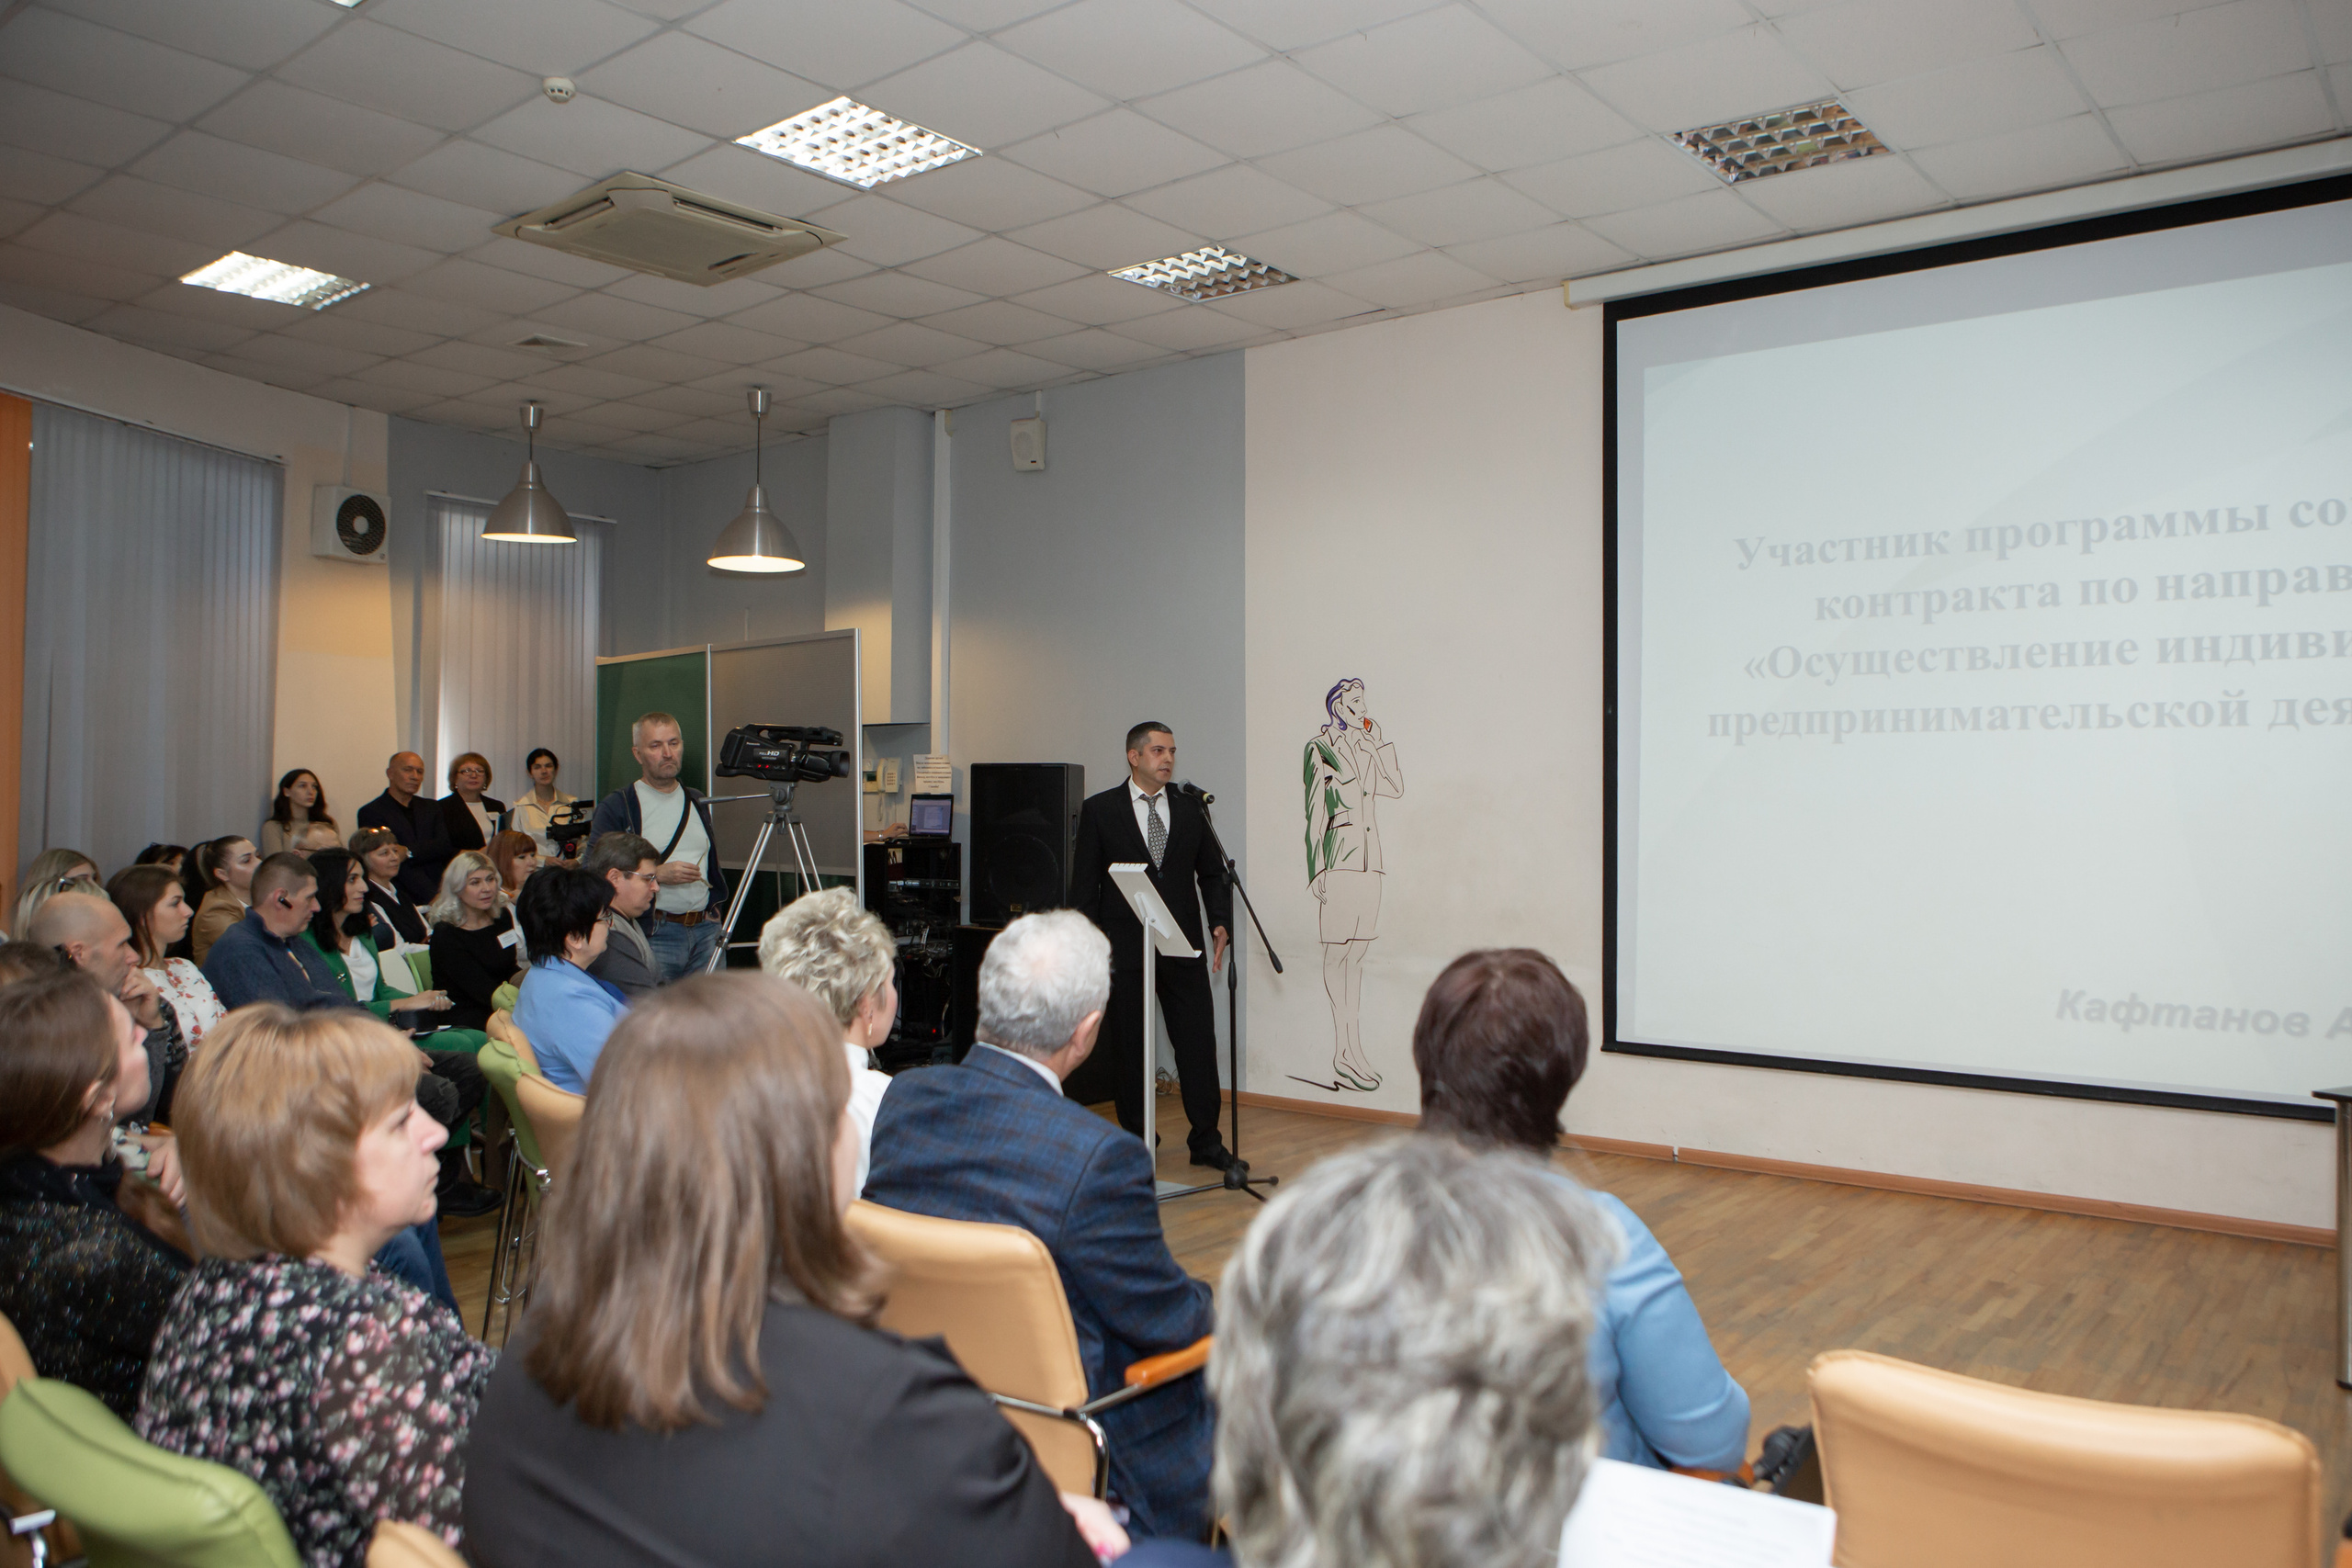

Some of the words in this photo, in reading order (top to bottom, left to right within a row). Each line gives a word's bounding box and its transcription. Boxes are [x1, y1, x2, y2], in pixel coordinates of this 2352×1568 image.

[1733, 529, 1951, 570] Участник
[1964, 504, 2270, 561] программы
[2289, 498, 2352, 529] со
[1815, 581, 2063, 625] контракта
[2078, 577, 2139, 606] по
[2154, 564, 2352, 607] направ
[1744, 638, 2140, 687] «Осуществление
[1707, 689, 2251, 746] предпринимательской
[2055, 987, 2312, 1038] Кафтанов
